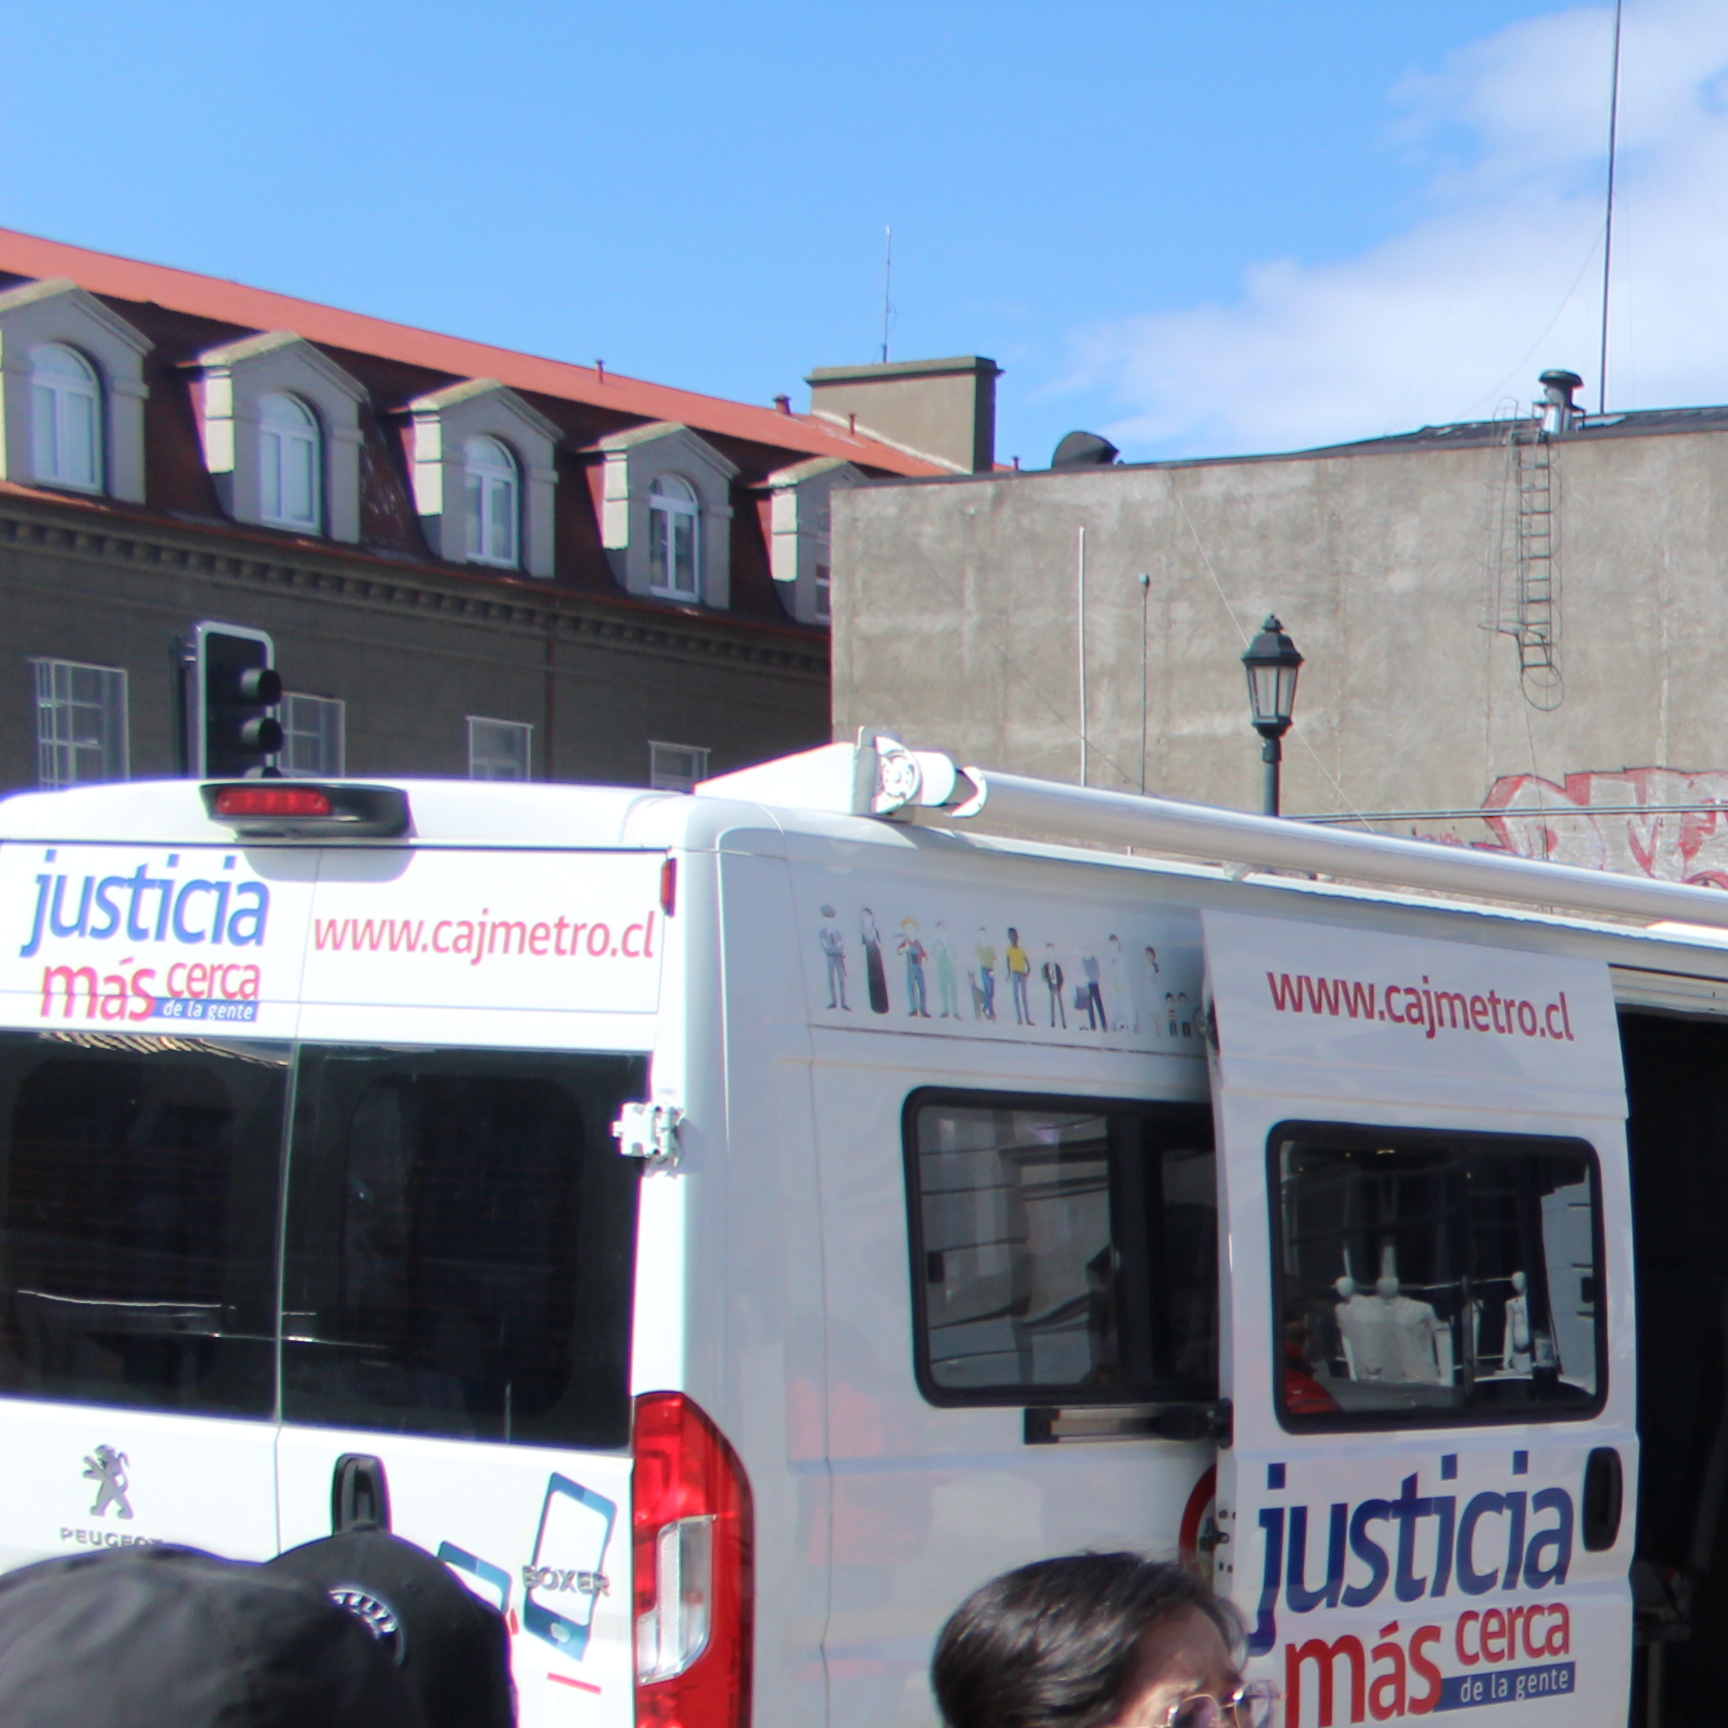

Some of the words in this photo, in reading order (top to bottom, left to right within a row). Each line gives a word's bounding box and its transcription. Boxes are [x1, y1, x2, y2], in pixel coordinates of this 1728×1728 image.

[19, 849, 271, 959] justicia
[314, 907, 656, 966] www.cajmetro.cl
[40, 956, 156, 1023] más
[166, 961, 261, 1001] cerca
[163, 1000, 182, 1018] de
[187, 1000, 203, 1018] la
[207, 1002, 254, 1021] gente
[1265, 971, 1575, 1041] www.cajmetro.cl
[531, 1565, 611, 1597] BOXER
[1246, 1450, 1574, 1658] justicia
[1455, 1602, 1570, 1667] cerca
[1460, 1676, 1484, 1703] de
[1491, 1673, 1508, 1699] la
[1515, 1668, 1569, 1702] gente
